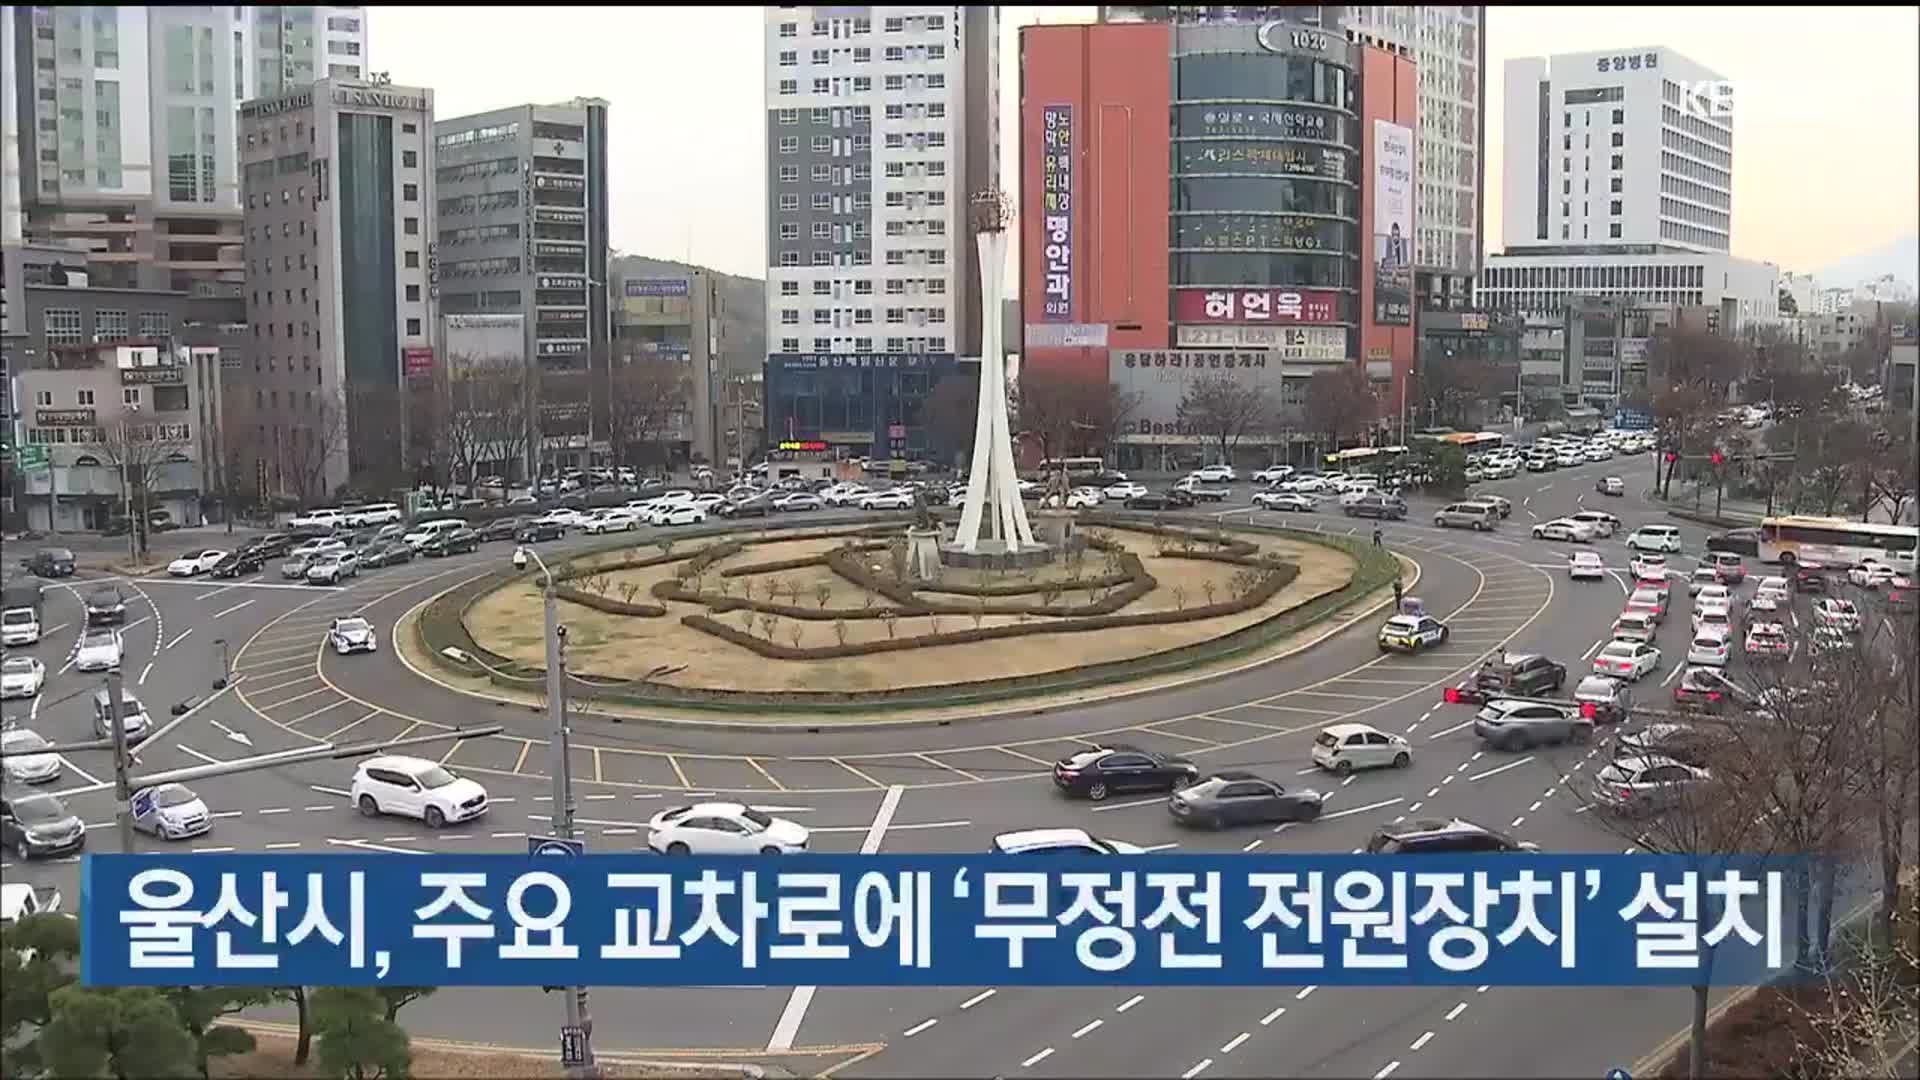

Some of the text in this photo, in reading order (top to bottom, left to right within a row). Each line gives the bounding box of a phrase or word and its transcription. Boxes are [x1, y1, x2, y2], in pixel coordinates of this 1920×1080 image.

[1290, 31, 1328, 50] 1020
[1596, 52, 1658, 72] 중앙병원
[1046, 216, 1070, 300] 명안과
